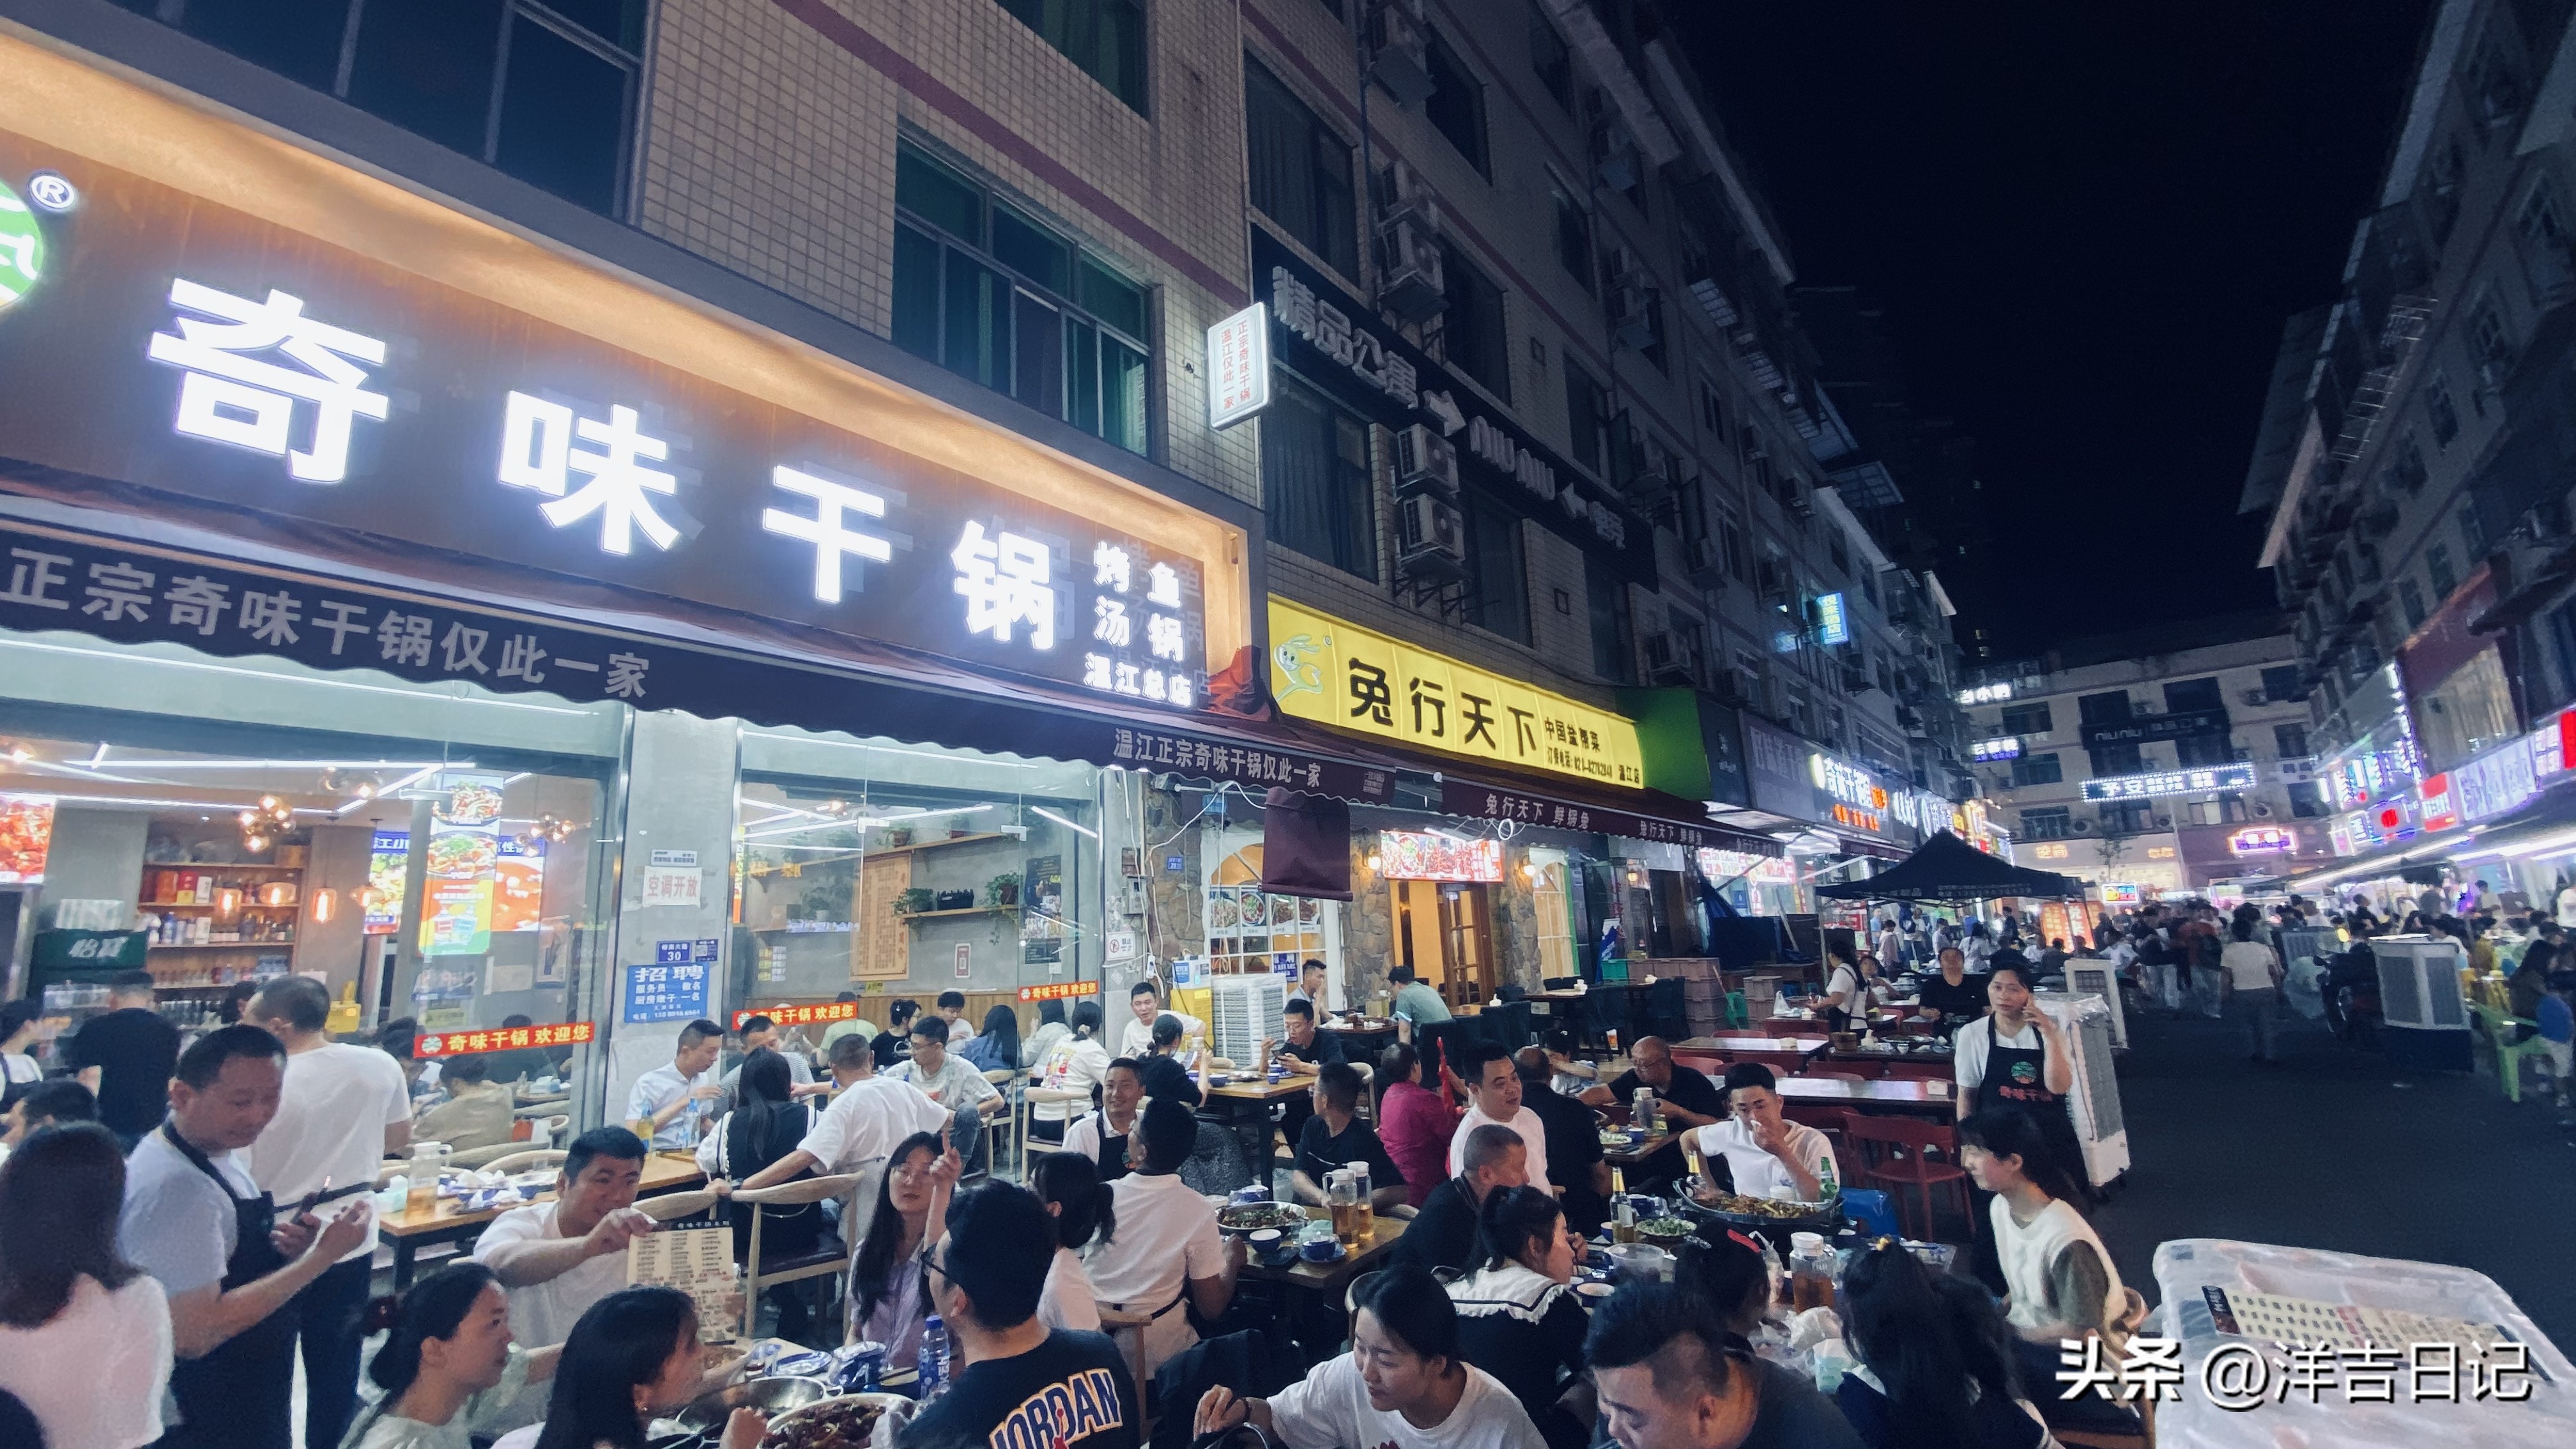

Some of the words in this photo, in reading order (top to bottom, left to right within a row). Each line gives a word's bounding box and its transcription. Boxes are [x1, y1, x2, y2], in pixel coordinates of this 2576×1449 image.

[1221, 328, 1234, 410] 温江仅此一家
[1237, 319, 1251, 402] 正宗奇味干锅
[148, 277, 1055, 650] 奇味干锅
[0, 546, 650, 699] 正宗奇味干锅仅此一家
[1094, 595, 1184, 663] 汤锅
[1348, 657, 1537, 756] 兔行天下
[1113, 727, 1321, 788] 温江正宗奇味干锅仅此一家
[1485, 793, 1544, 822] 兔行天下
[648, 874, 698, 898] 空调开放
[634, 965, 704, 983] 招聘
[667, 951, 682, 961] 30
[756, 1008, 811, 1024] 味干锅
[815, 1004, 854, 1020] 欢迎您
[1032, 985, 1069, 999] 奇味干锅
[448, 1029, 529, 1052] 奇味干锅
[534, 1024, 590, 1044] 欢迎您
[988, 1368, 1123, 1449] ORDAN
